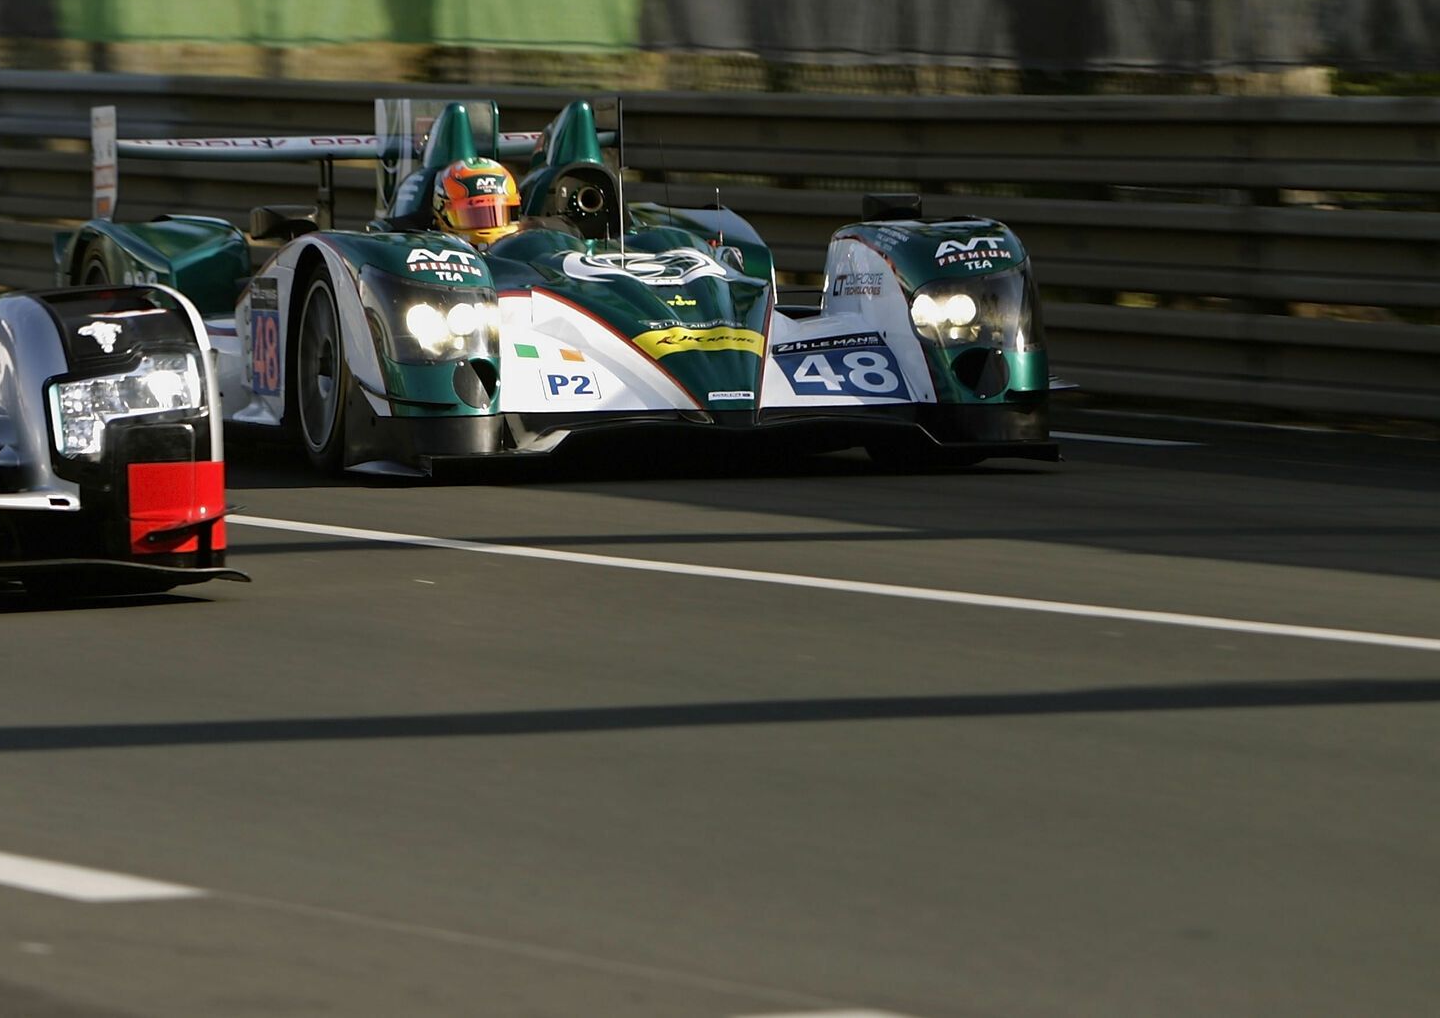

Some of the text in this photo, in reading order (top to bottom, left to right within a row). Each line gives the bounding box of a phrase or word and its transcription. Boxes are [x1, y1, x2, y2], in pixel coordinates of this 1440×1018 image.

[935, 237, 1004, 259] AVT
[406, 248, 475, 265] AVT
[938, 250, 1011, 266] PREMIUM
[409, 262, 482, 277] PREMIUM
[964, 260, 992, 270] TEA
[435, 271, 464, 282] TEA
[833, 336, 879, 346] MANS
[253, 315, 278, 391] 48
[793, 351, 899, 393] 48
[546, 374, 594, 395] P2
